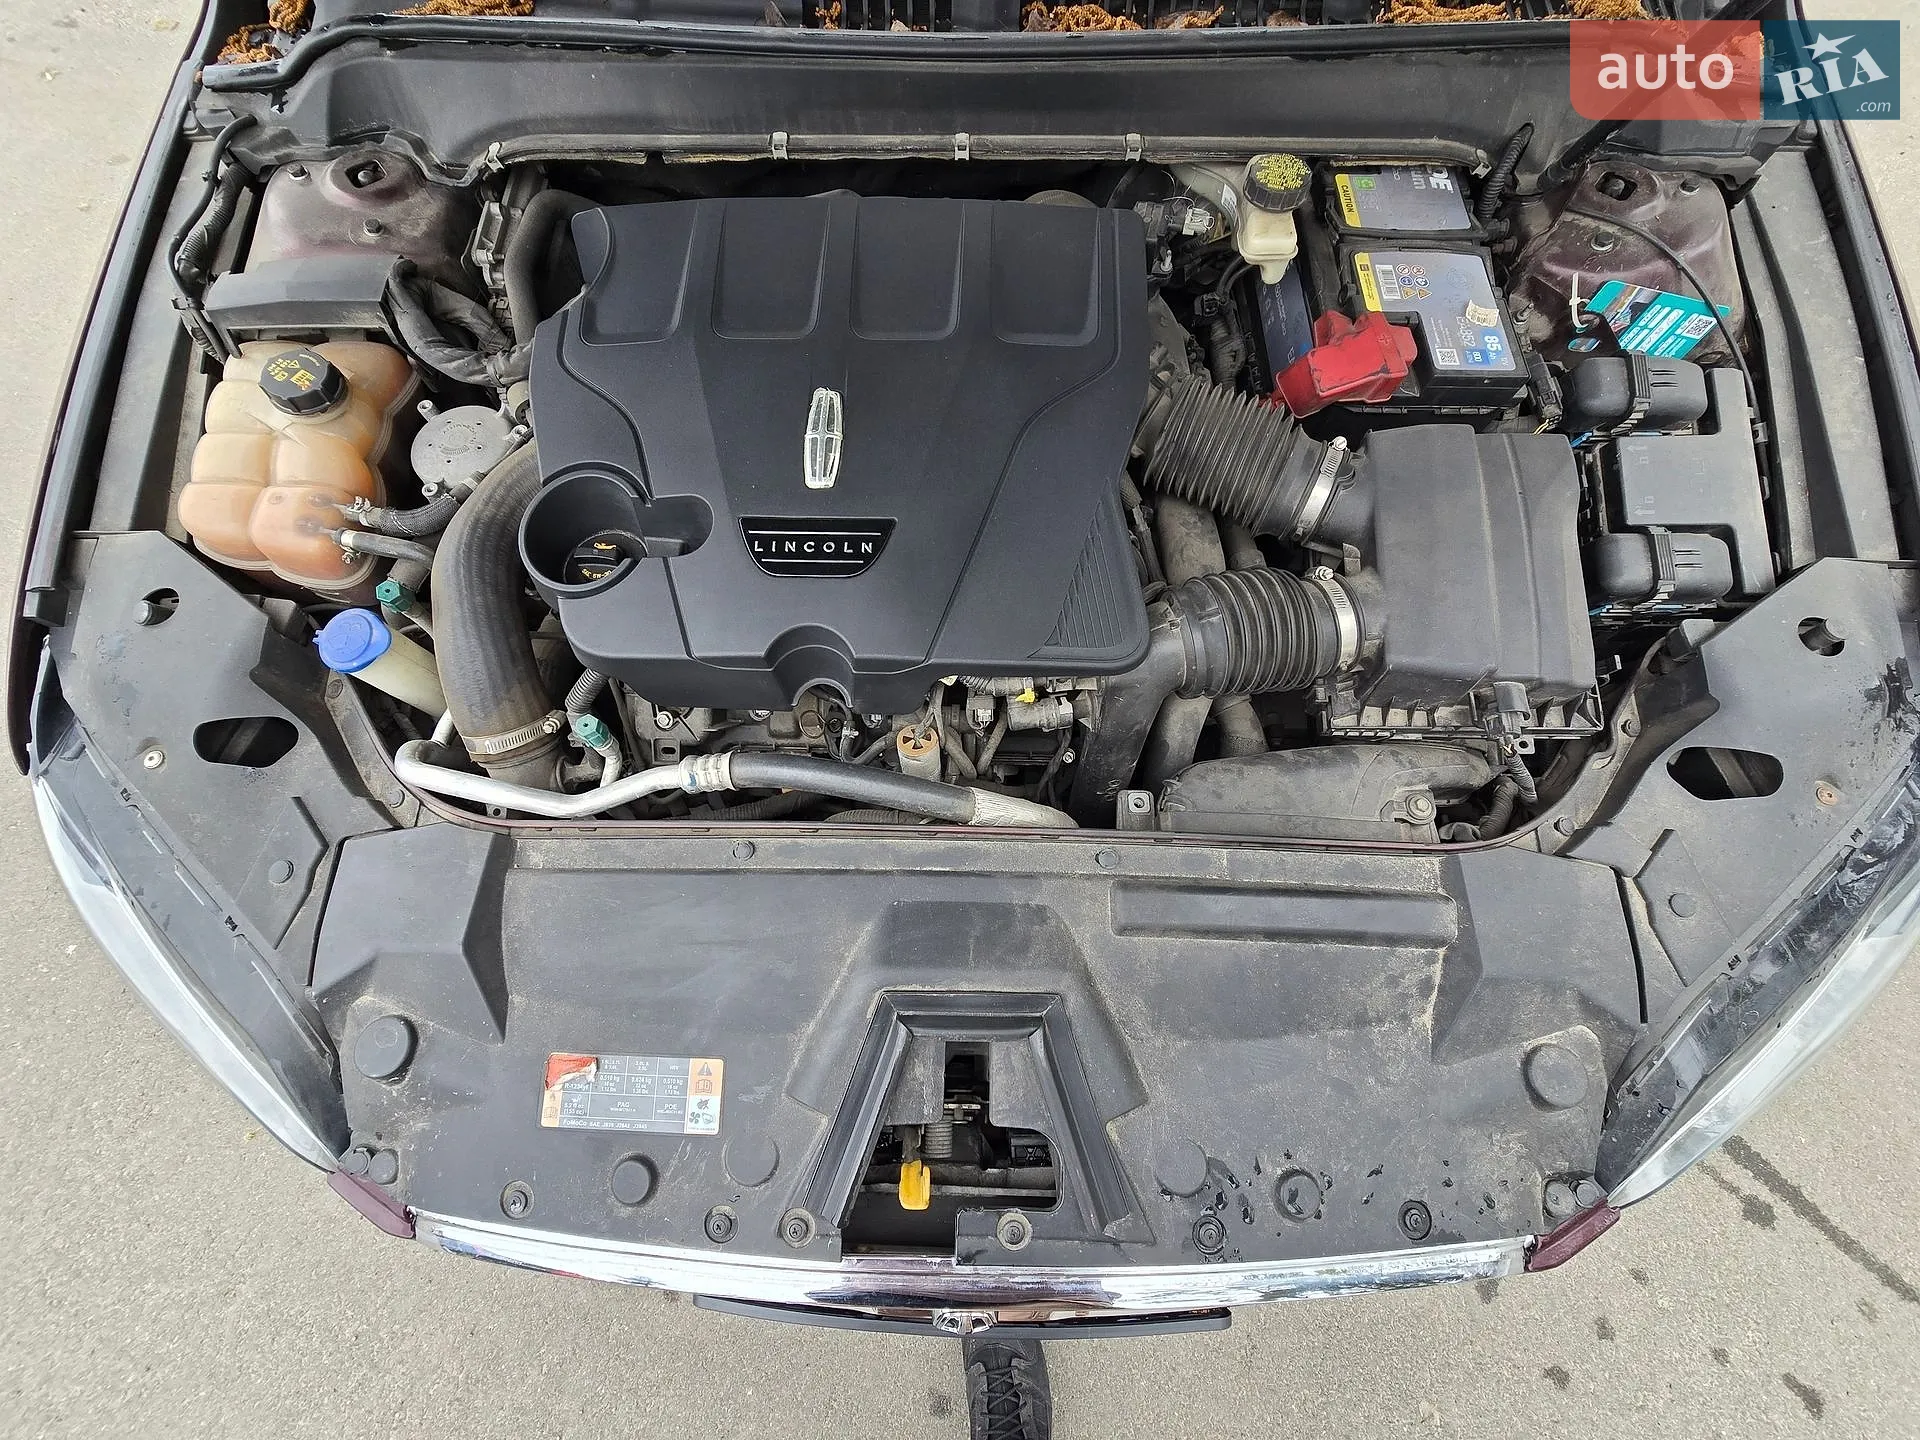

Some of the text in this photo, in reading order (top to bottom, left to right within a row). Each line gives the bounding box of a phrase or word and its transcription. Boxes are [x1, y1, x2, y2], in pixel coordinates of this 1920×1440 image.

[1341, 185, 1354, 213] CAUTION
[1484, 335, 1503, 351] 85
[754, 541, 872, 553] LINCOLN
[563, 1119, 587, 1127] FoMoCo
